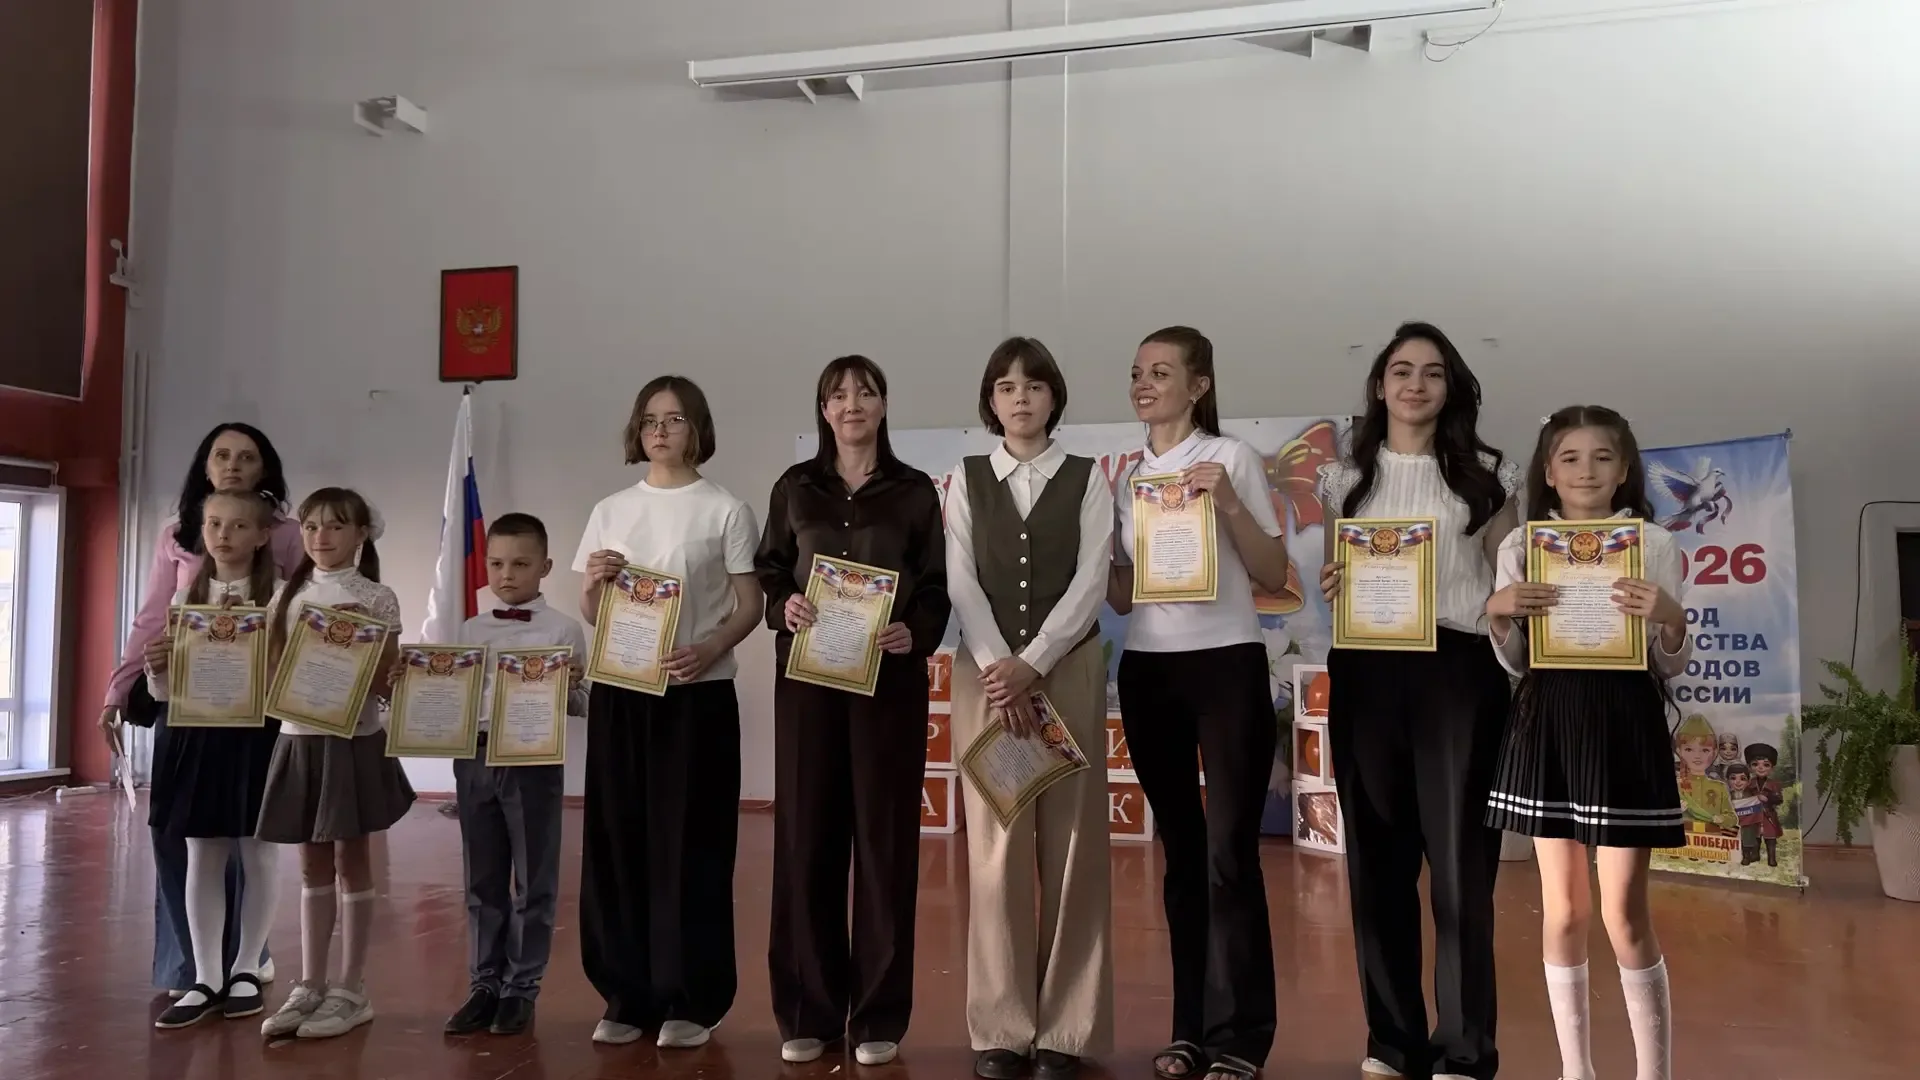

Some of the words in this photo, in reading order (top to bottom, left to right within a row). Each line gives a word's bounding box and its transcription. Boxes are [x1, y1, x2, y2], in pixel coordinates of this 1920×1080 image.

[1681, 543, 1767, 585] 26
[1689, 633, 1769, 651] СТВА
[1108, 792, 1133, 824] К
[1693, 835, 1740, 852] ПОБЕДУ!
